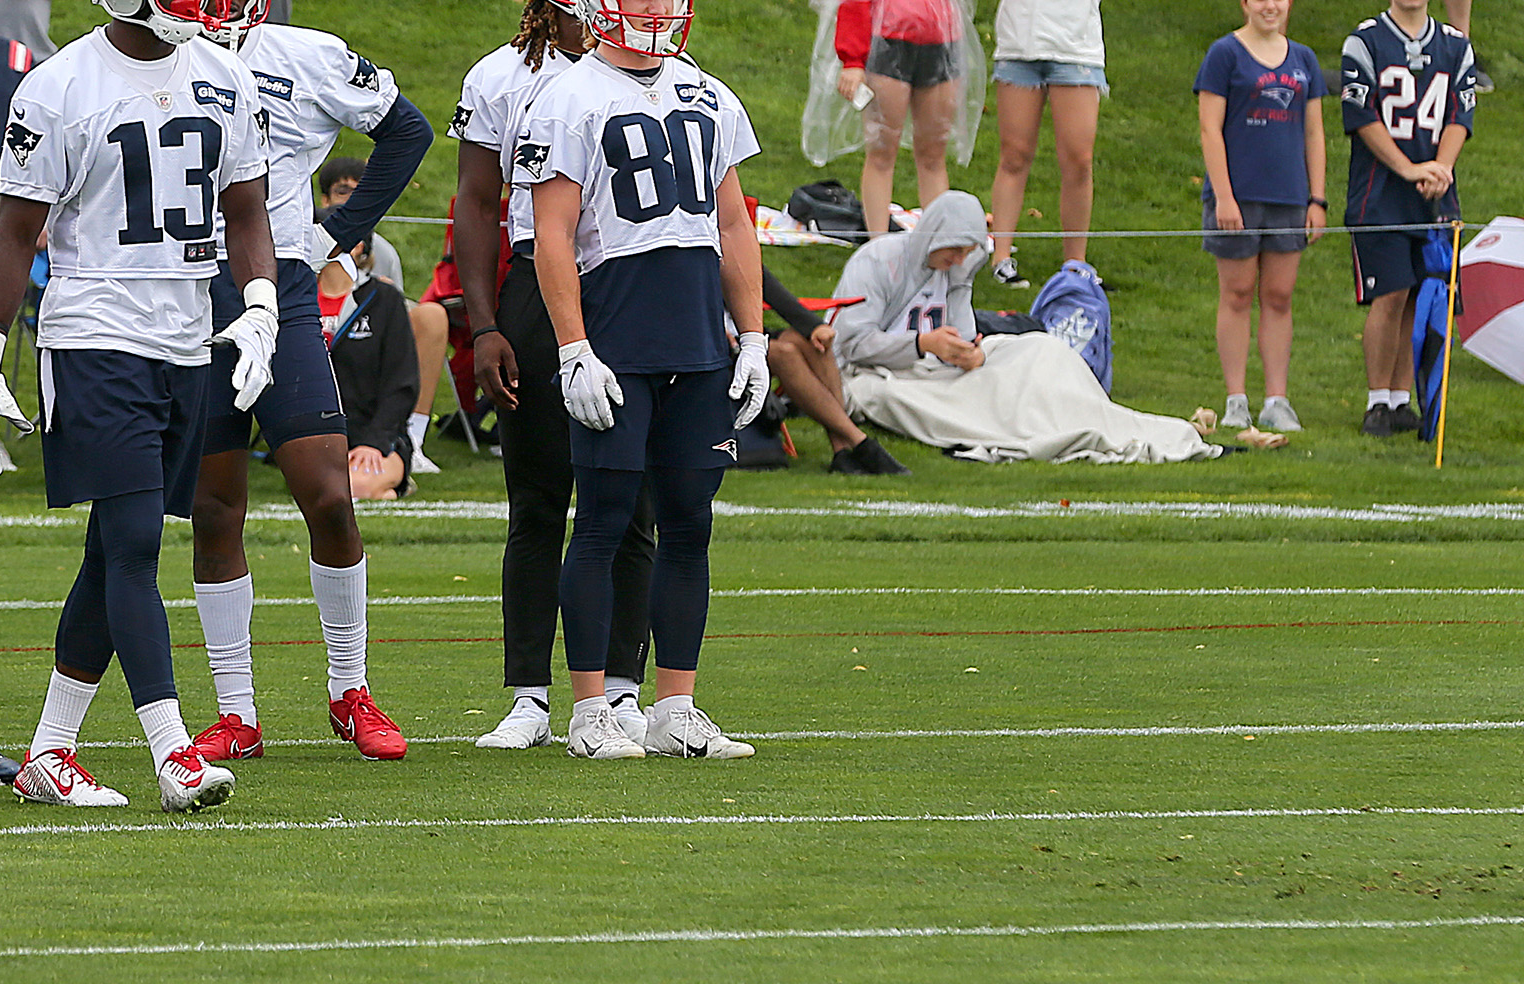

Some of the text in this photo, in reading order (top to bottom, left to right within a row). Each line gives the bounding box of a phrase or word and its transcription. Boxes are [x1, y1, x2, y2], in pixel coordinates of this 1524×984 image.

[1380, 64, 1451, 144] 24
[107, 116, 222, 245] 13
[601, 110, 716, 224] 80
